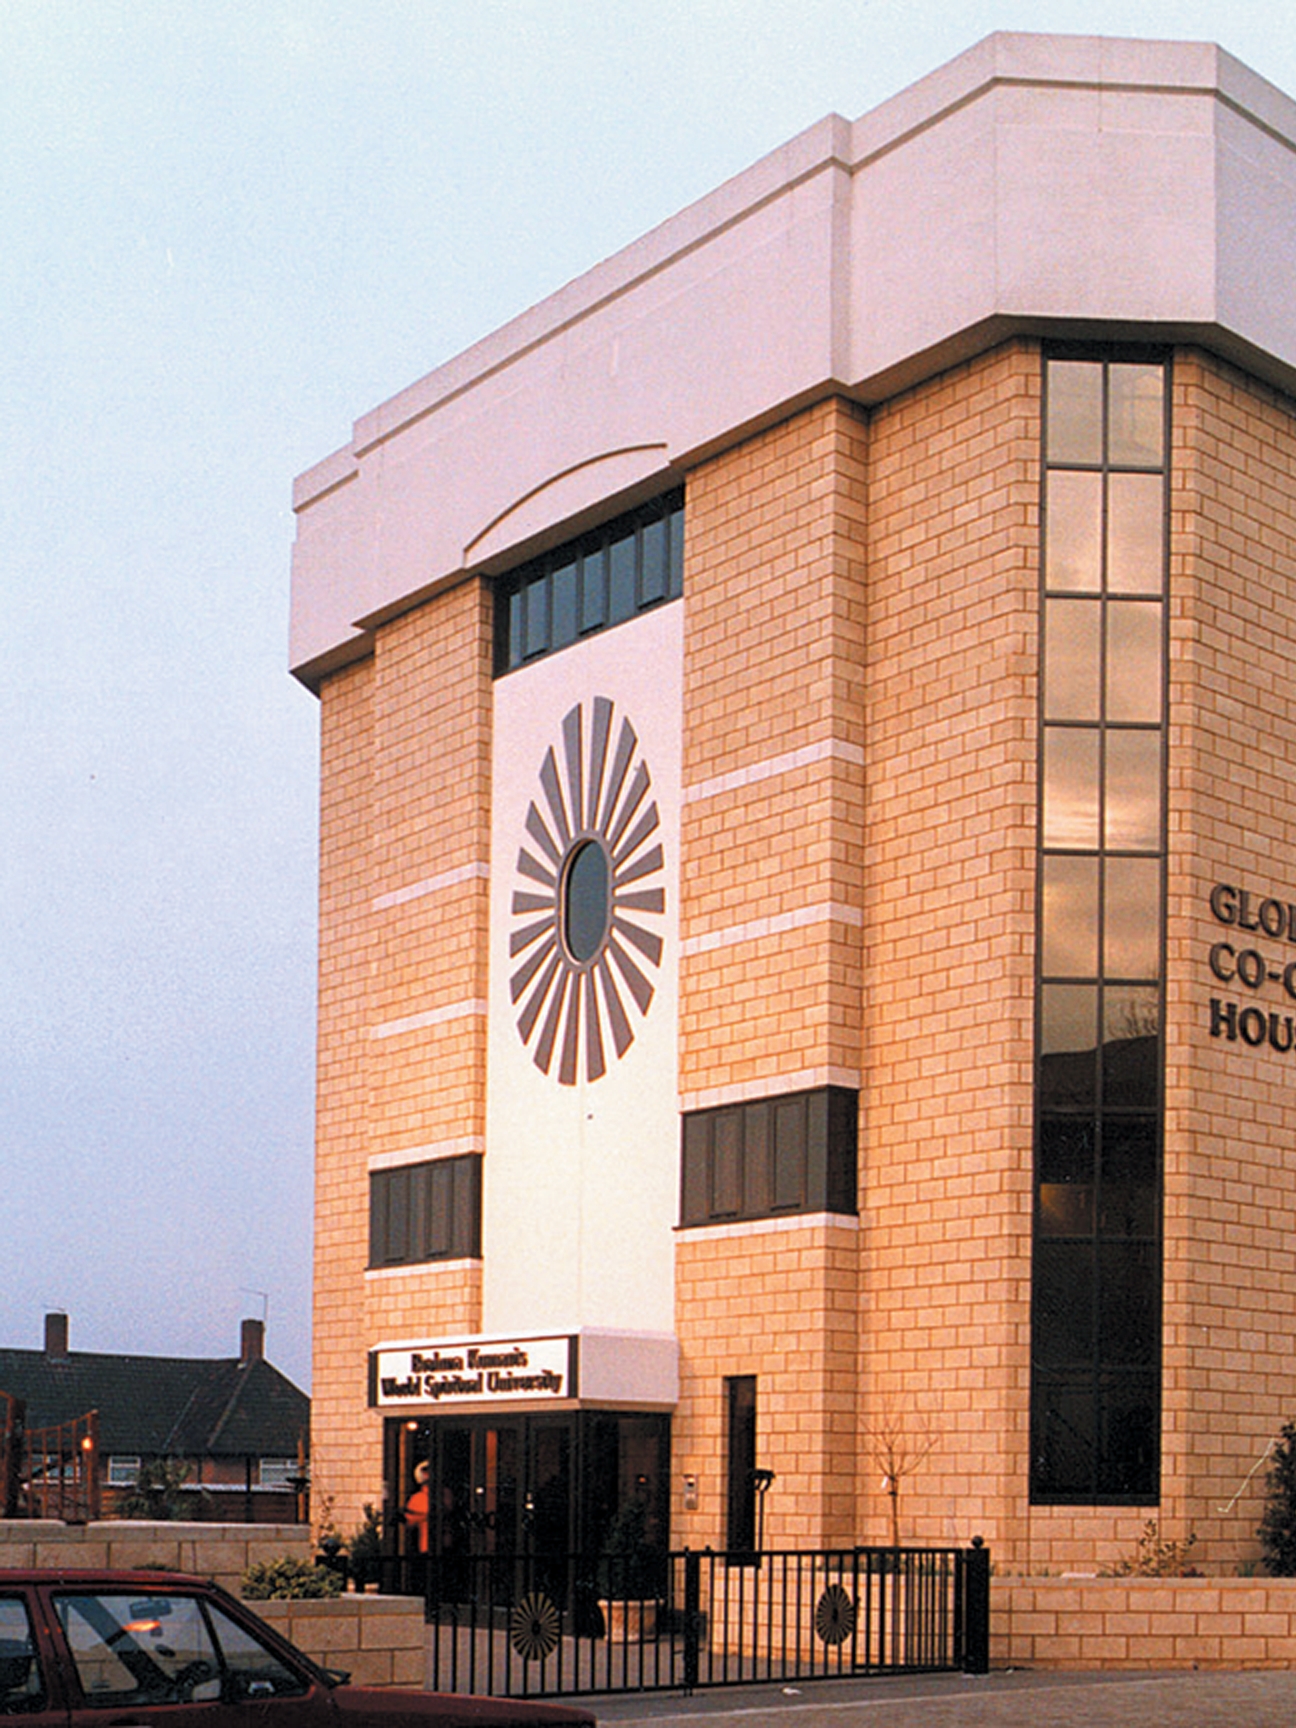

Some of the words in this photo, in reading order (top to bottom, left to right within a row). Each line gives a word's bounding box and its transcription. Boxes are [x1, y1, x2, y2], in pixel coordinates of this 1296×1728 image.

[381, 1376, 421, 1397] World
[424, 1372, 484, 1400] Spiritual
[486, 1369, 563, 1394] University
